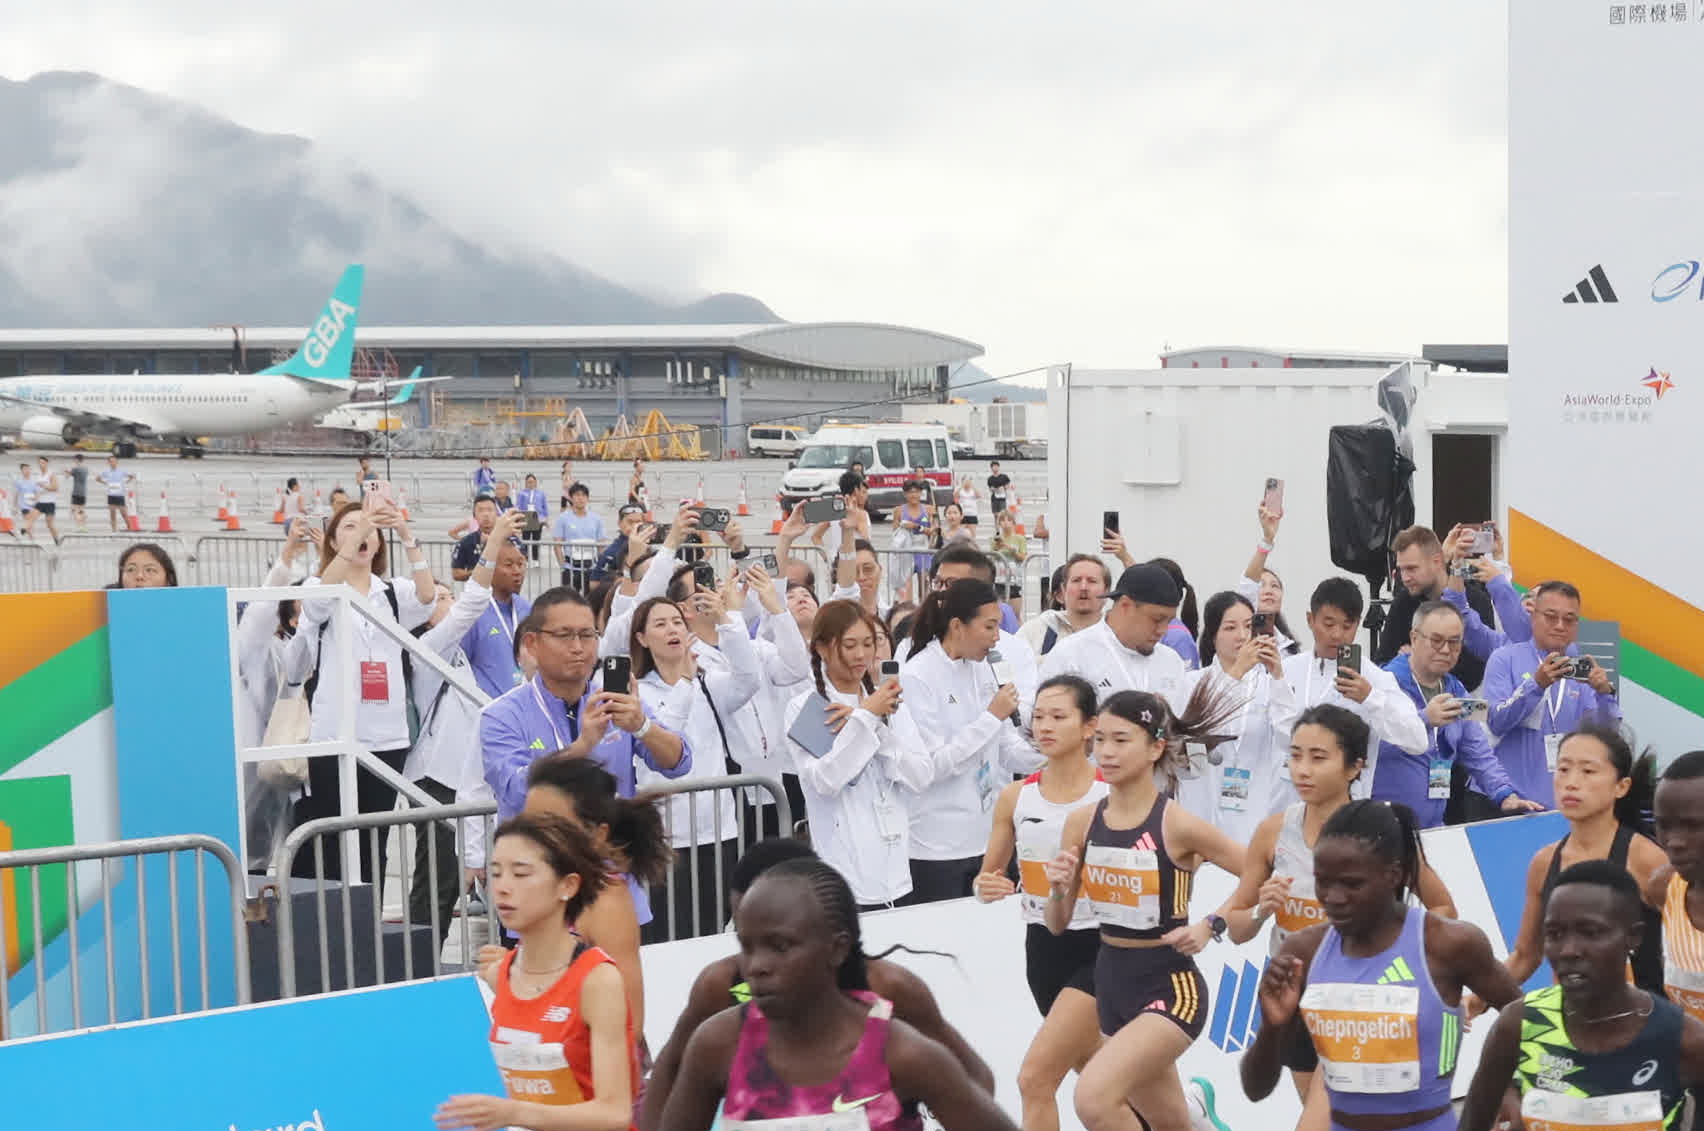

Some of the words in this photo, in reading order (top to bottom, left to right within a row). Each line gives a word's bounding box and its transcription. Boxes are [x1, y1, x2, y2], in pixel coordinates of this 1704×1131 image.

[302, 298, 355, 368] GBA
[1087, 865, 1143, 894] Wong
[1305, 1011, 1412, 1044] Chepngetich
[1352, 1047, 1361, 1060] 3
